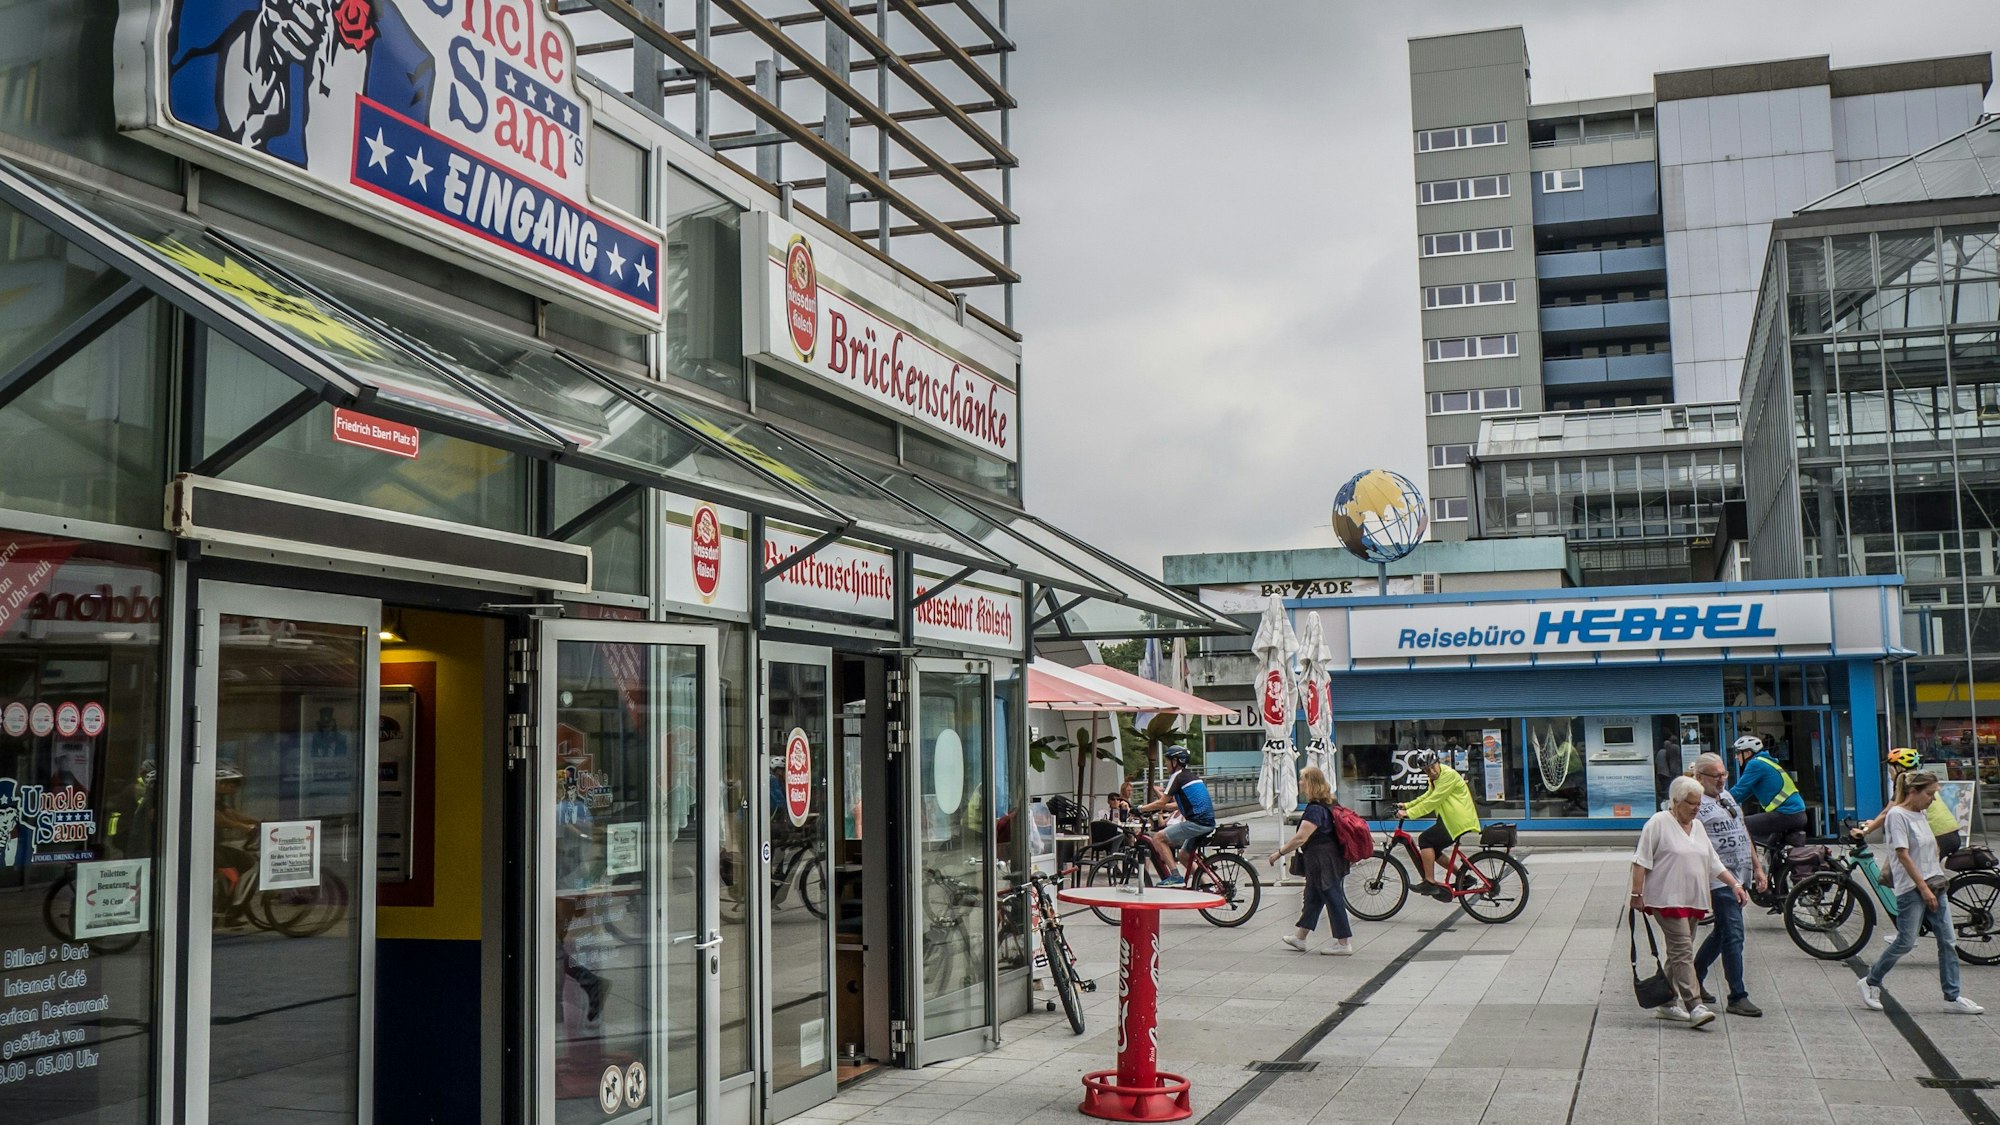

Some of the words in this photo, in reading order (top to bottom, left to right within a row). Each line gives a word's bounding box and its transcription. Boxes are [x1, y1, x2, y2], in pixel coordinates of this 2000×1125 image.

[449, 36, 583, 179] Sam's
[444, 152, 598, 273] EINGANG
[827, 308, 1007, 448] Brückenschänke
[337, 416, 371, 436] Friedrich
[372, 425, 392, 441] Ebert
[393, 430, 411, 446] Platz
[411, 435, 417, 447] 9
[7, 585, 29, 609] Uhr
[27, 559, 52, 587] früh
[1398, 628, 1526, 650] Reisebüro
[1532, 603, 1777, 645] HEBBEL
[21, 785, 87, 817] Uncle
[36, 811, 96, 844] Sam's
[53, 853, 75, 861] DRINKS
[80, 852, 93, 860] FUN
[4, 946, 46, 969] Billard
[61, 943, 89, 961] Dart
[4, 974, 55, 997] Internet
[58, 969, 87, 989] Café
[0, 1007, 38, 1026] erican
[42, 995, 109, 1020] Restaurant
[3, 1029, 60, 1060] geöffnet
[62, 1028, 85, 1044] von
[36, 1052, 73, 1077] 05.00
[76, 1049, 99, 1068] Uhr
